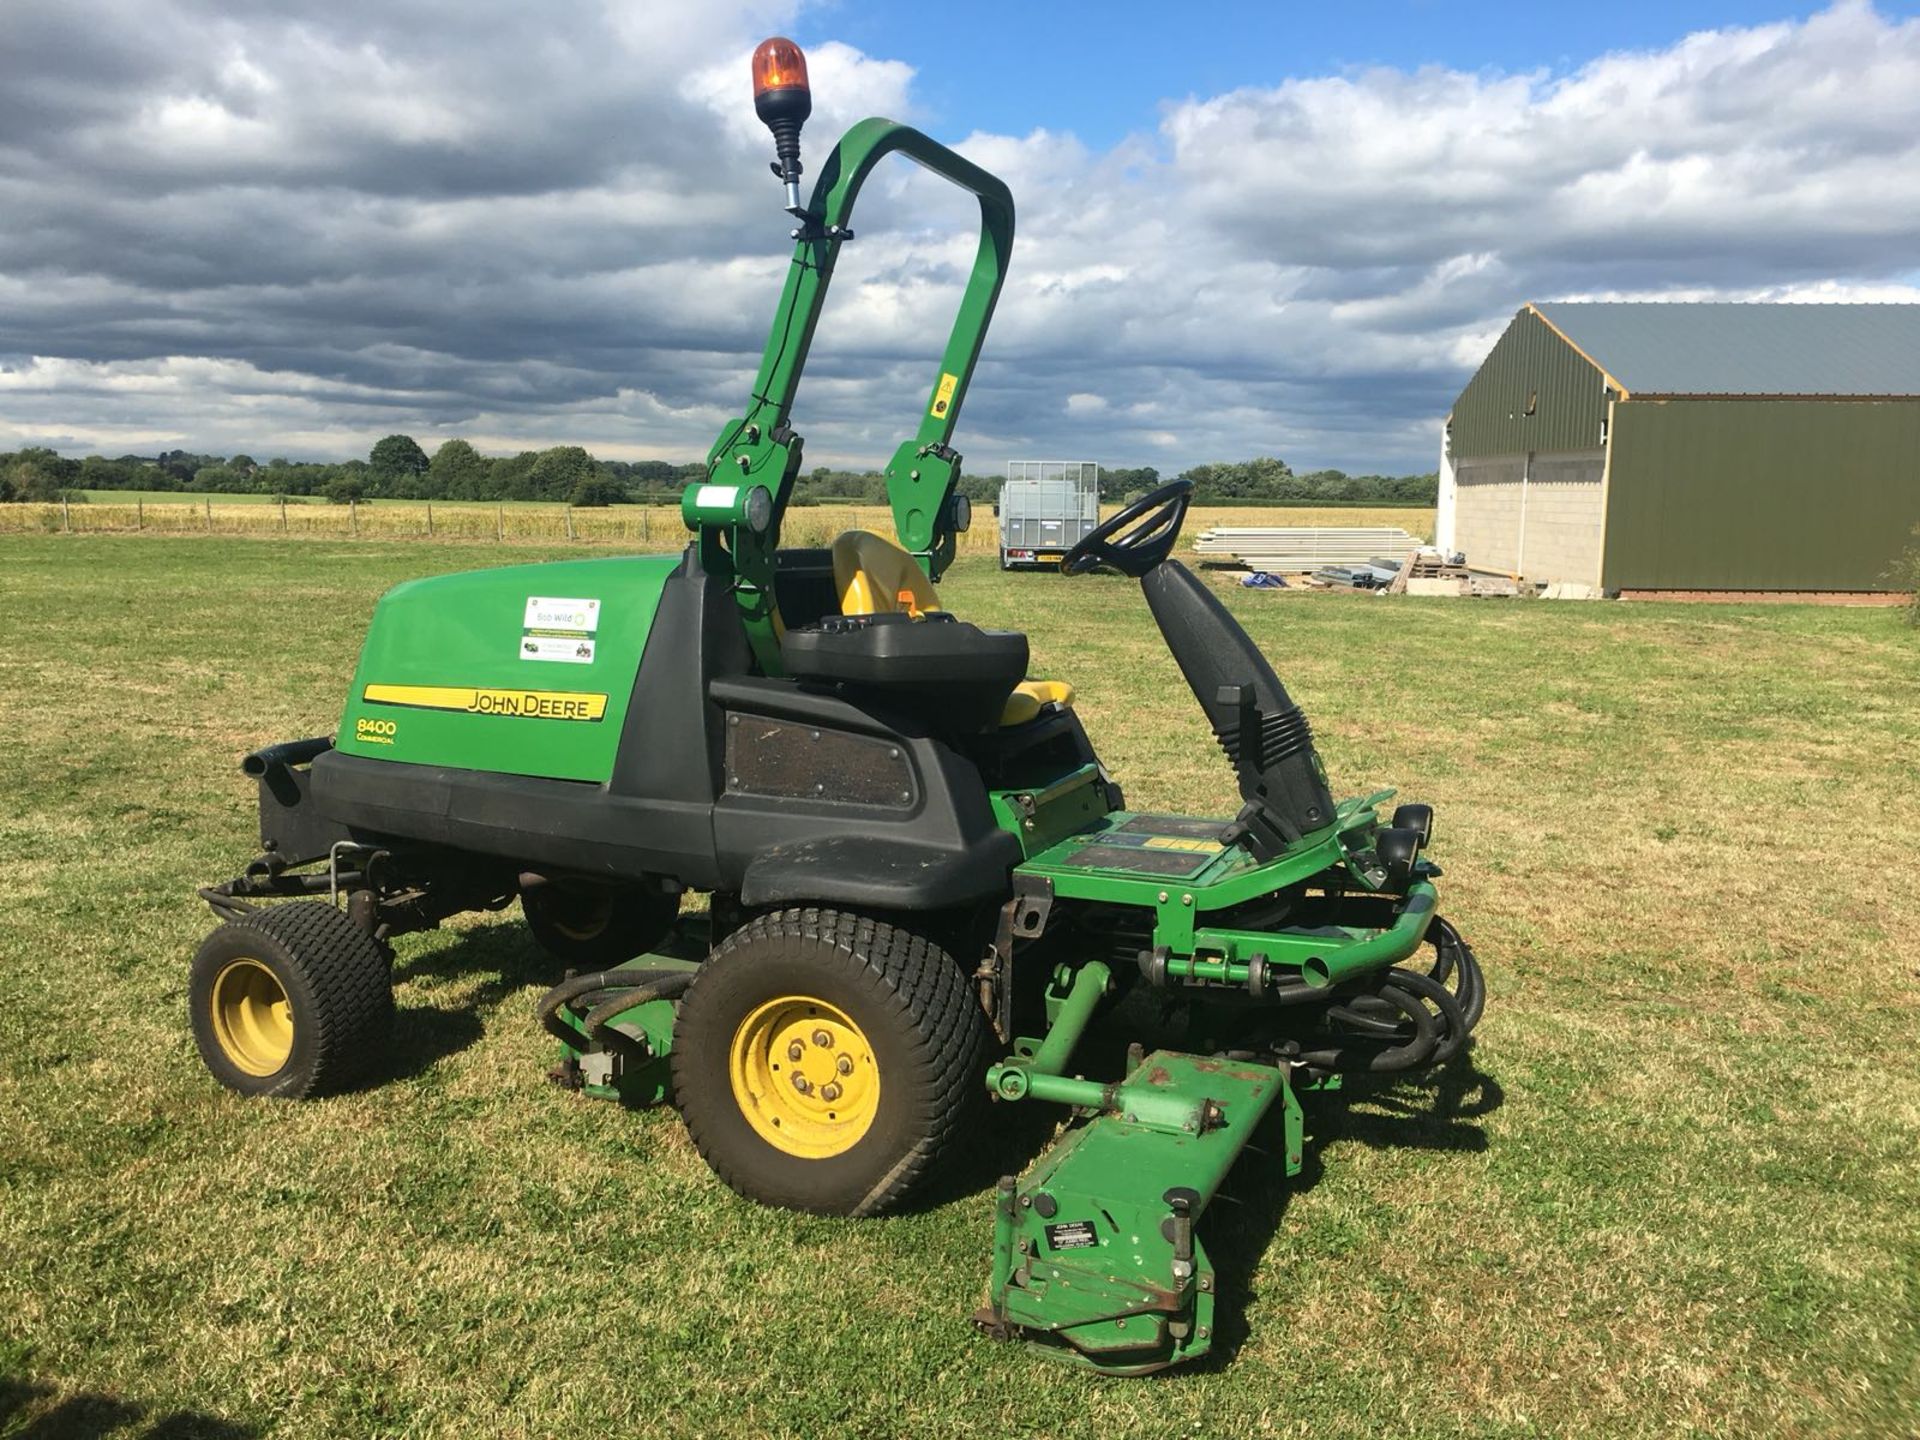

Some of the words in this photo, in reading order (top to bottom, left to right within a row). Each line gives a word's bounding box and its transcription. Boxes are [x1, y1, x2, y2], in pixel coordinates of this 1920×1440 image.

[468, 691, 519, 712] JOHN
[524, 695, 589, 717] DEERE
[357, 718, 397, 735] 8400
